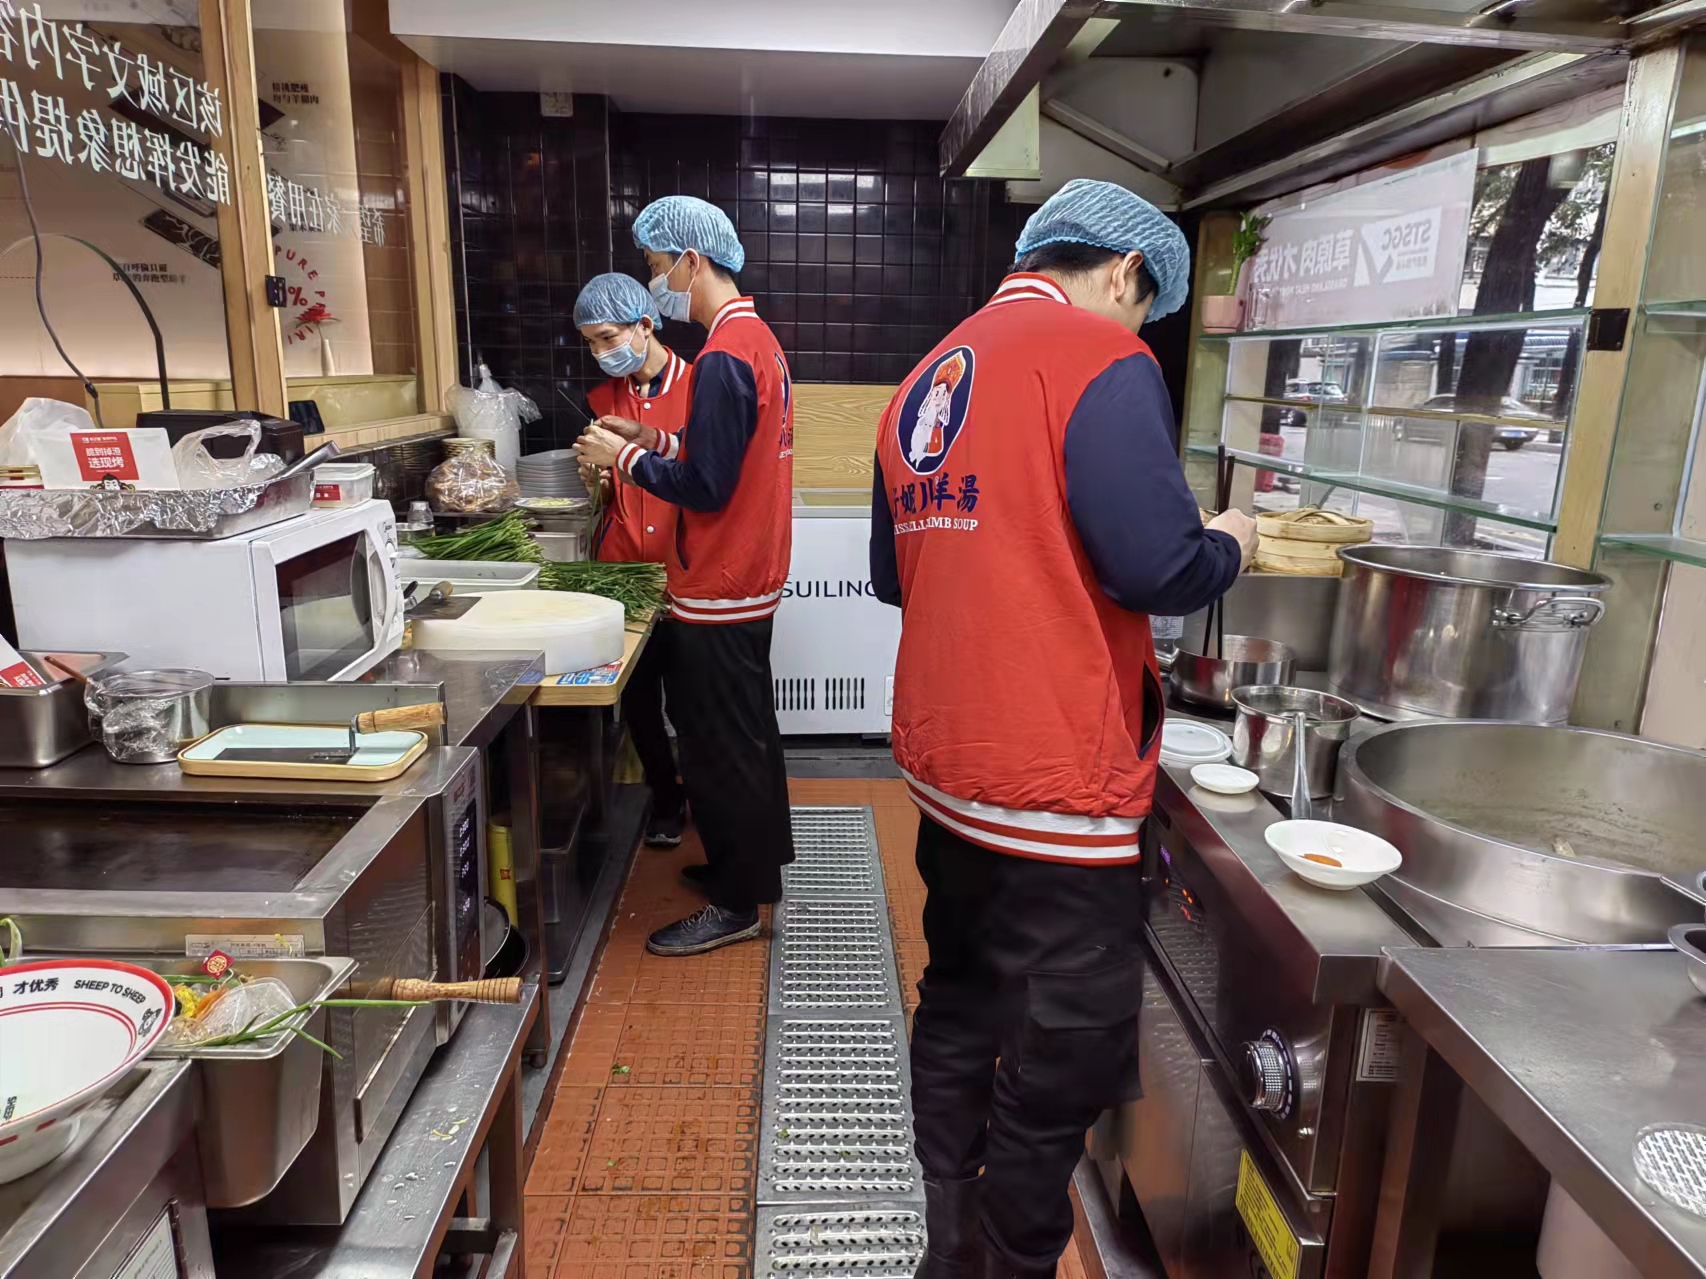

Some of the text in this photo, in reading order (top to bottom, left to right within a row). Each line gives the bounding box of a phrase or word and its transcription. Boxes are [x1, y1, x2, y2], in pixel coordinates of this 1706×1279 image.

[953, 518, 979, 531] SOUP
[13, 977, 59, 994] 才优秀
[74, 979, 147, 1004] SHEEP TO SHEEP
